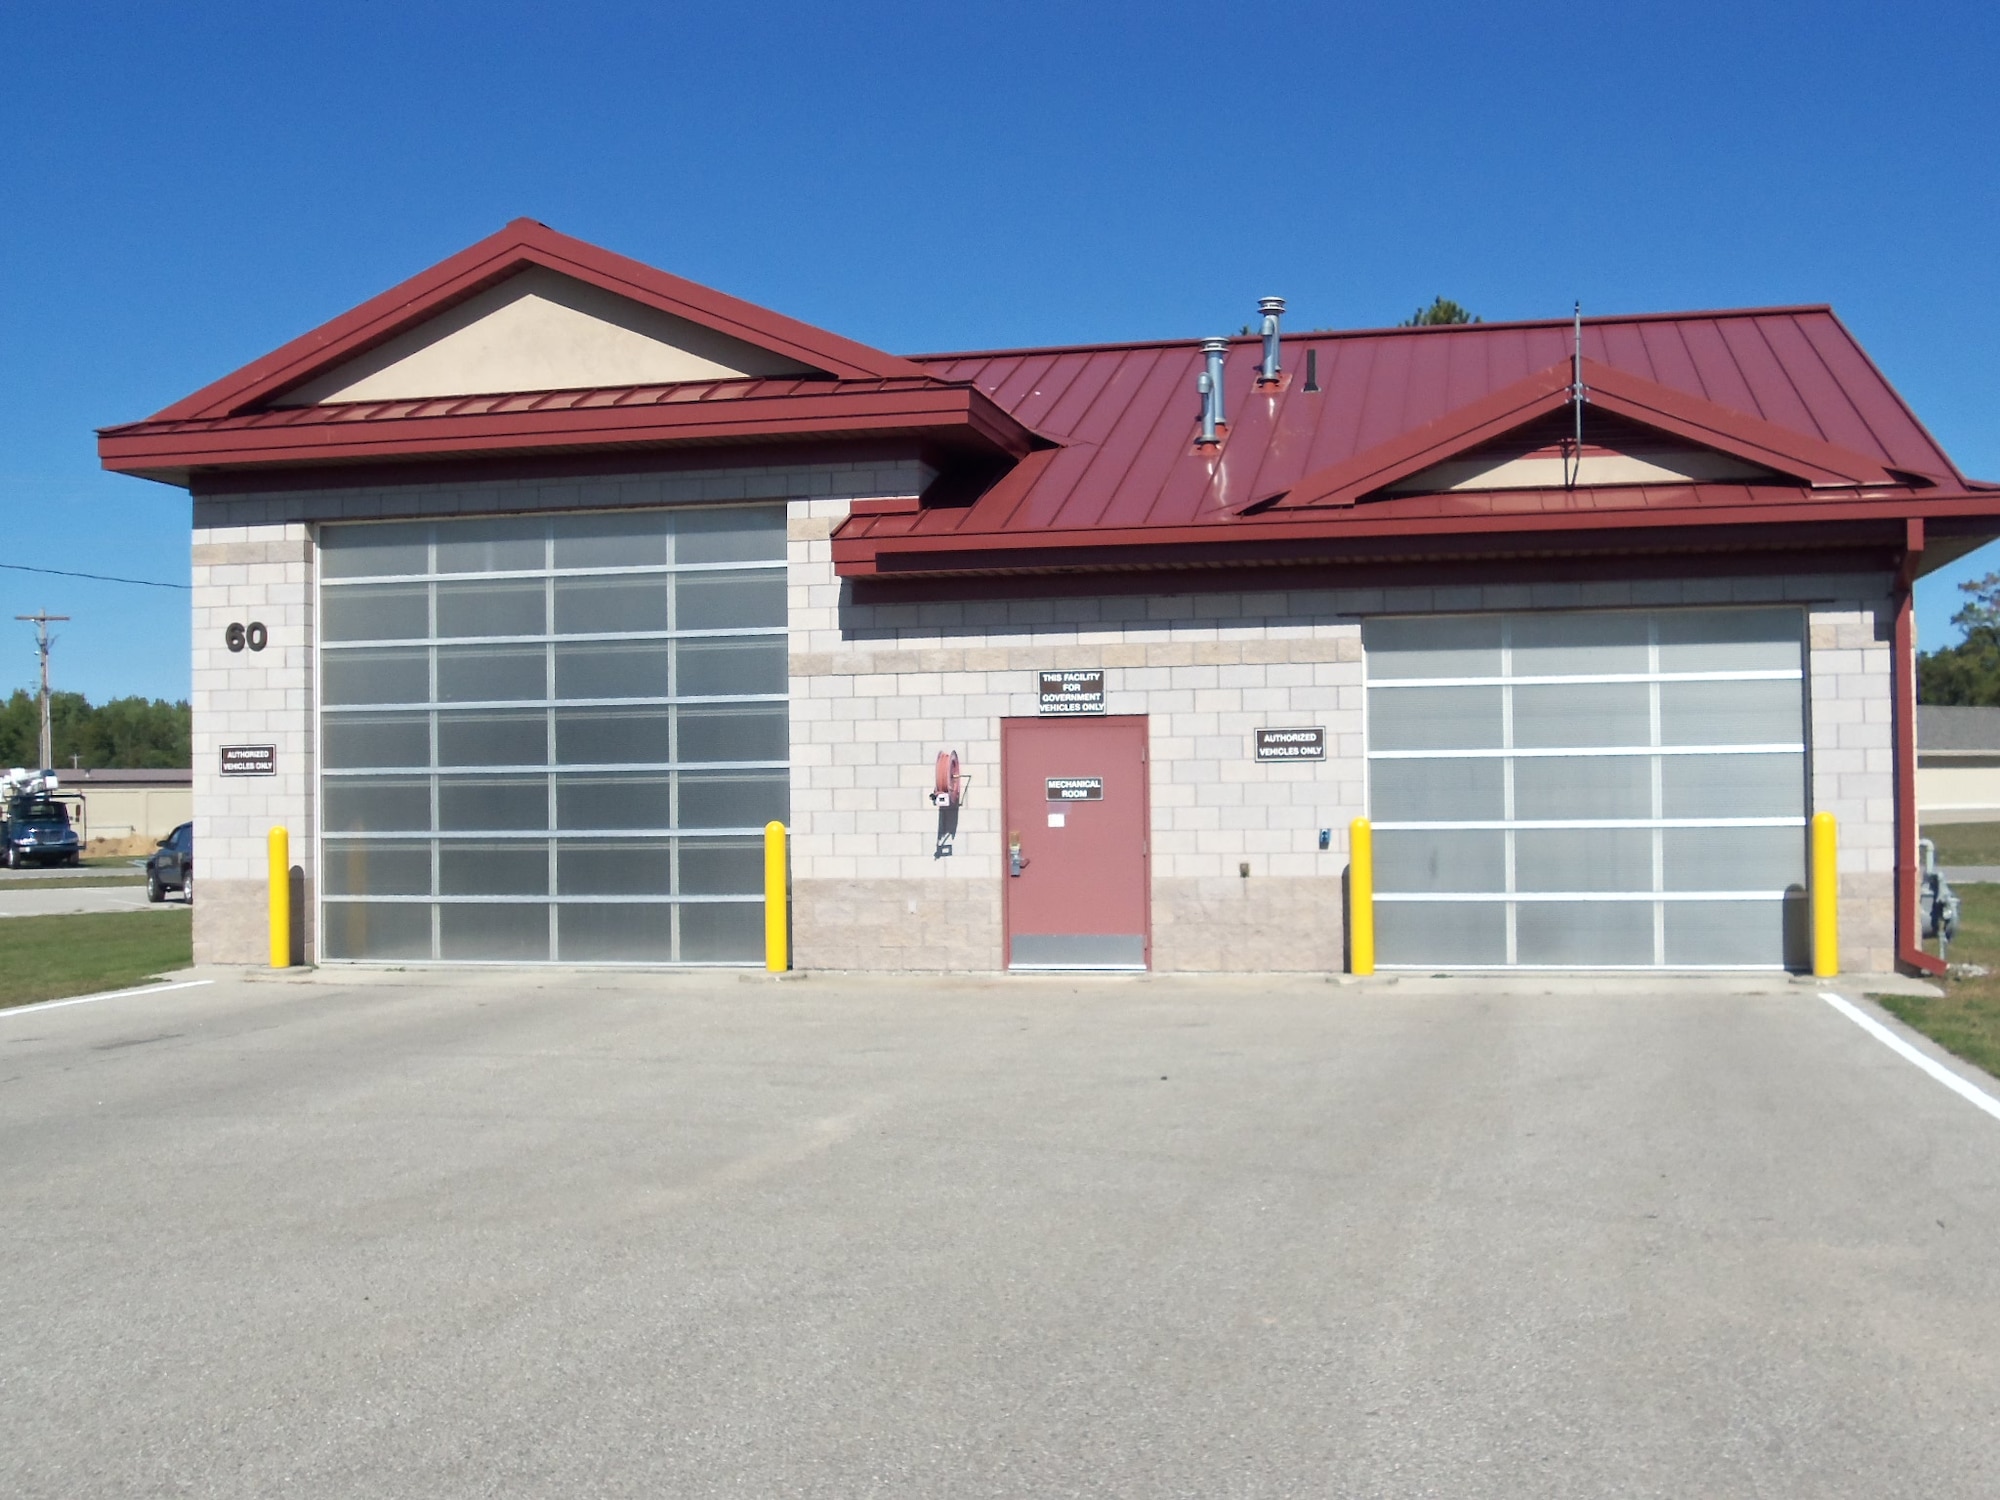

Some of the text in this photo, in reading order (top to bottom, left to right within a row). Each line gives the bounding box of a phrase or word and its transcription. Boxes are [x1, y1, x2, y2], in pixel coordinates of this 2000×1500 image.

[225, 621, 268, 653] 60
[1042, 673, 1101, 682] THIS FACILITY
[1062, 683, 1081, 692] FOR
[1042, 693, 1102, 702] GOVERNMENT
[1039, 702, 1105, 712] VEHICLES ONLY
[1263, 733, 1317, 743] AUTHORIZED
[227, 750, 270, 759] AUTHORIZED
[1259, 746, 1322, 756] VEHICLES ONLY
[223, 761, 273, 771] VEHICLES ONLY
[1048, 780, 1101, 789] MECHANICAL
[1061, 789, 1088, 798] ROOM
